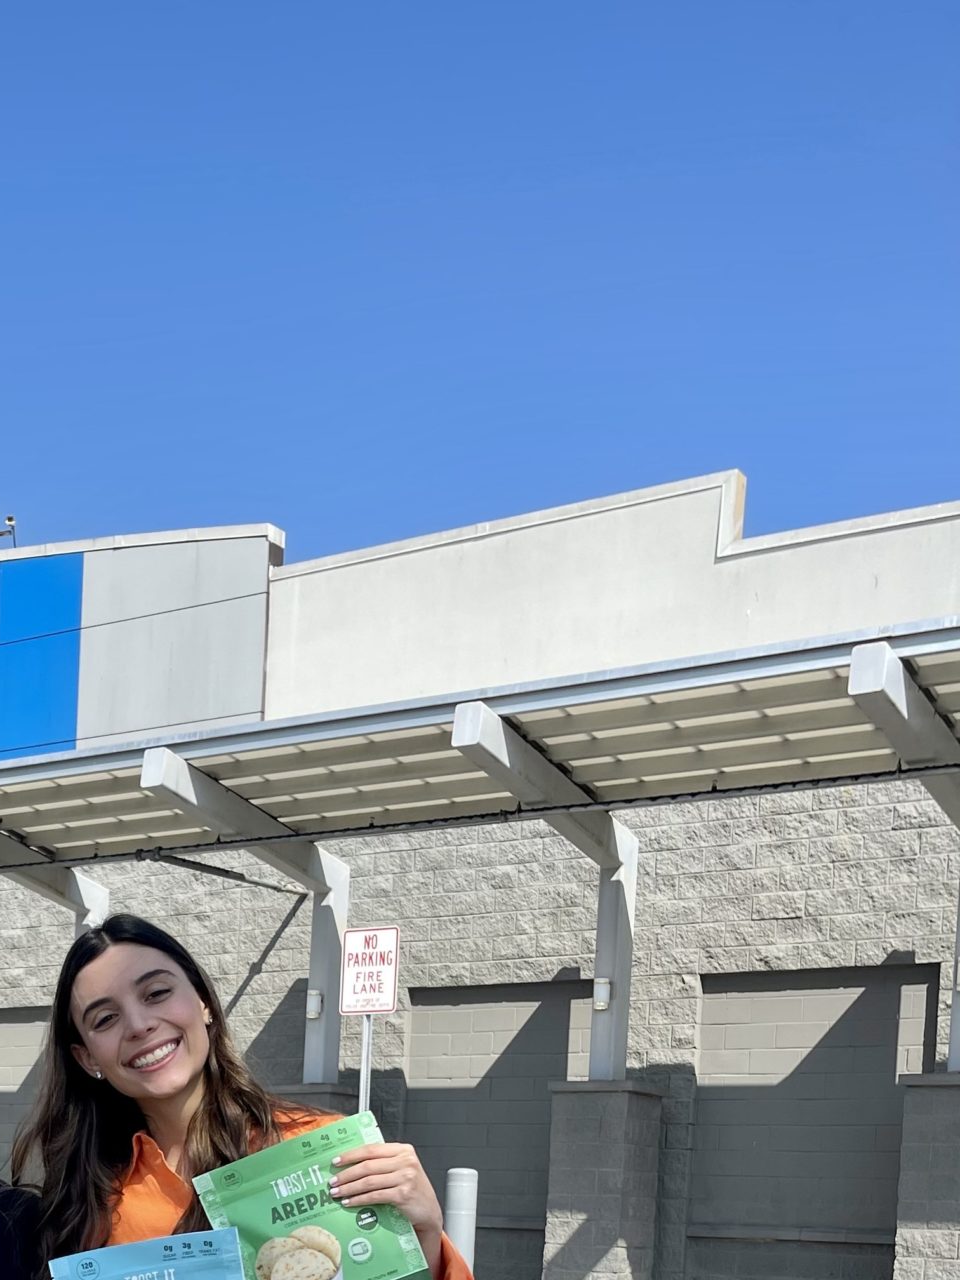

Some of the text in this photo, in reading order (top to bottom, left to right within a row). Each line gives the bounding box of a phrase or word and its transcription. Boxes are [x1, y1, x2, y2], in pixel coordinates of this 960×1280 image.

[364, 934, 378, 950] NO
[347, 950, 393, 968] PARKING
[356, 971, 382, 983] FIRE
[353, 983, 384, 994] LANE
[271, 1189, 331, 1224] AREPA
